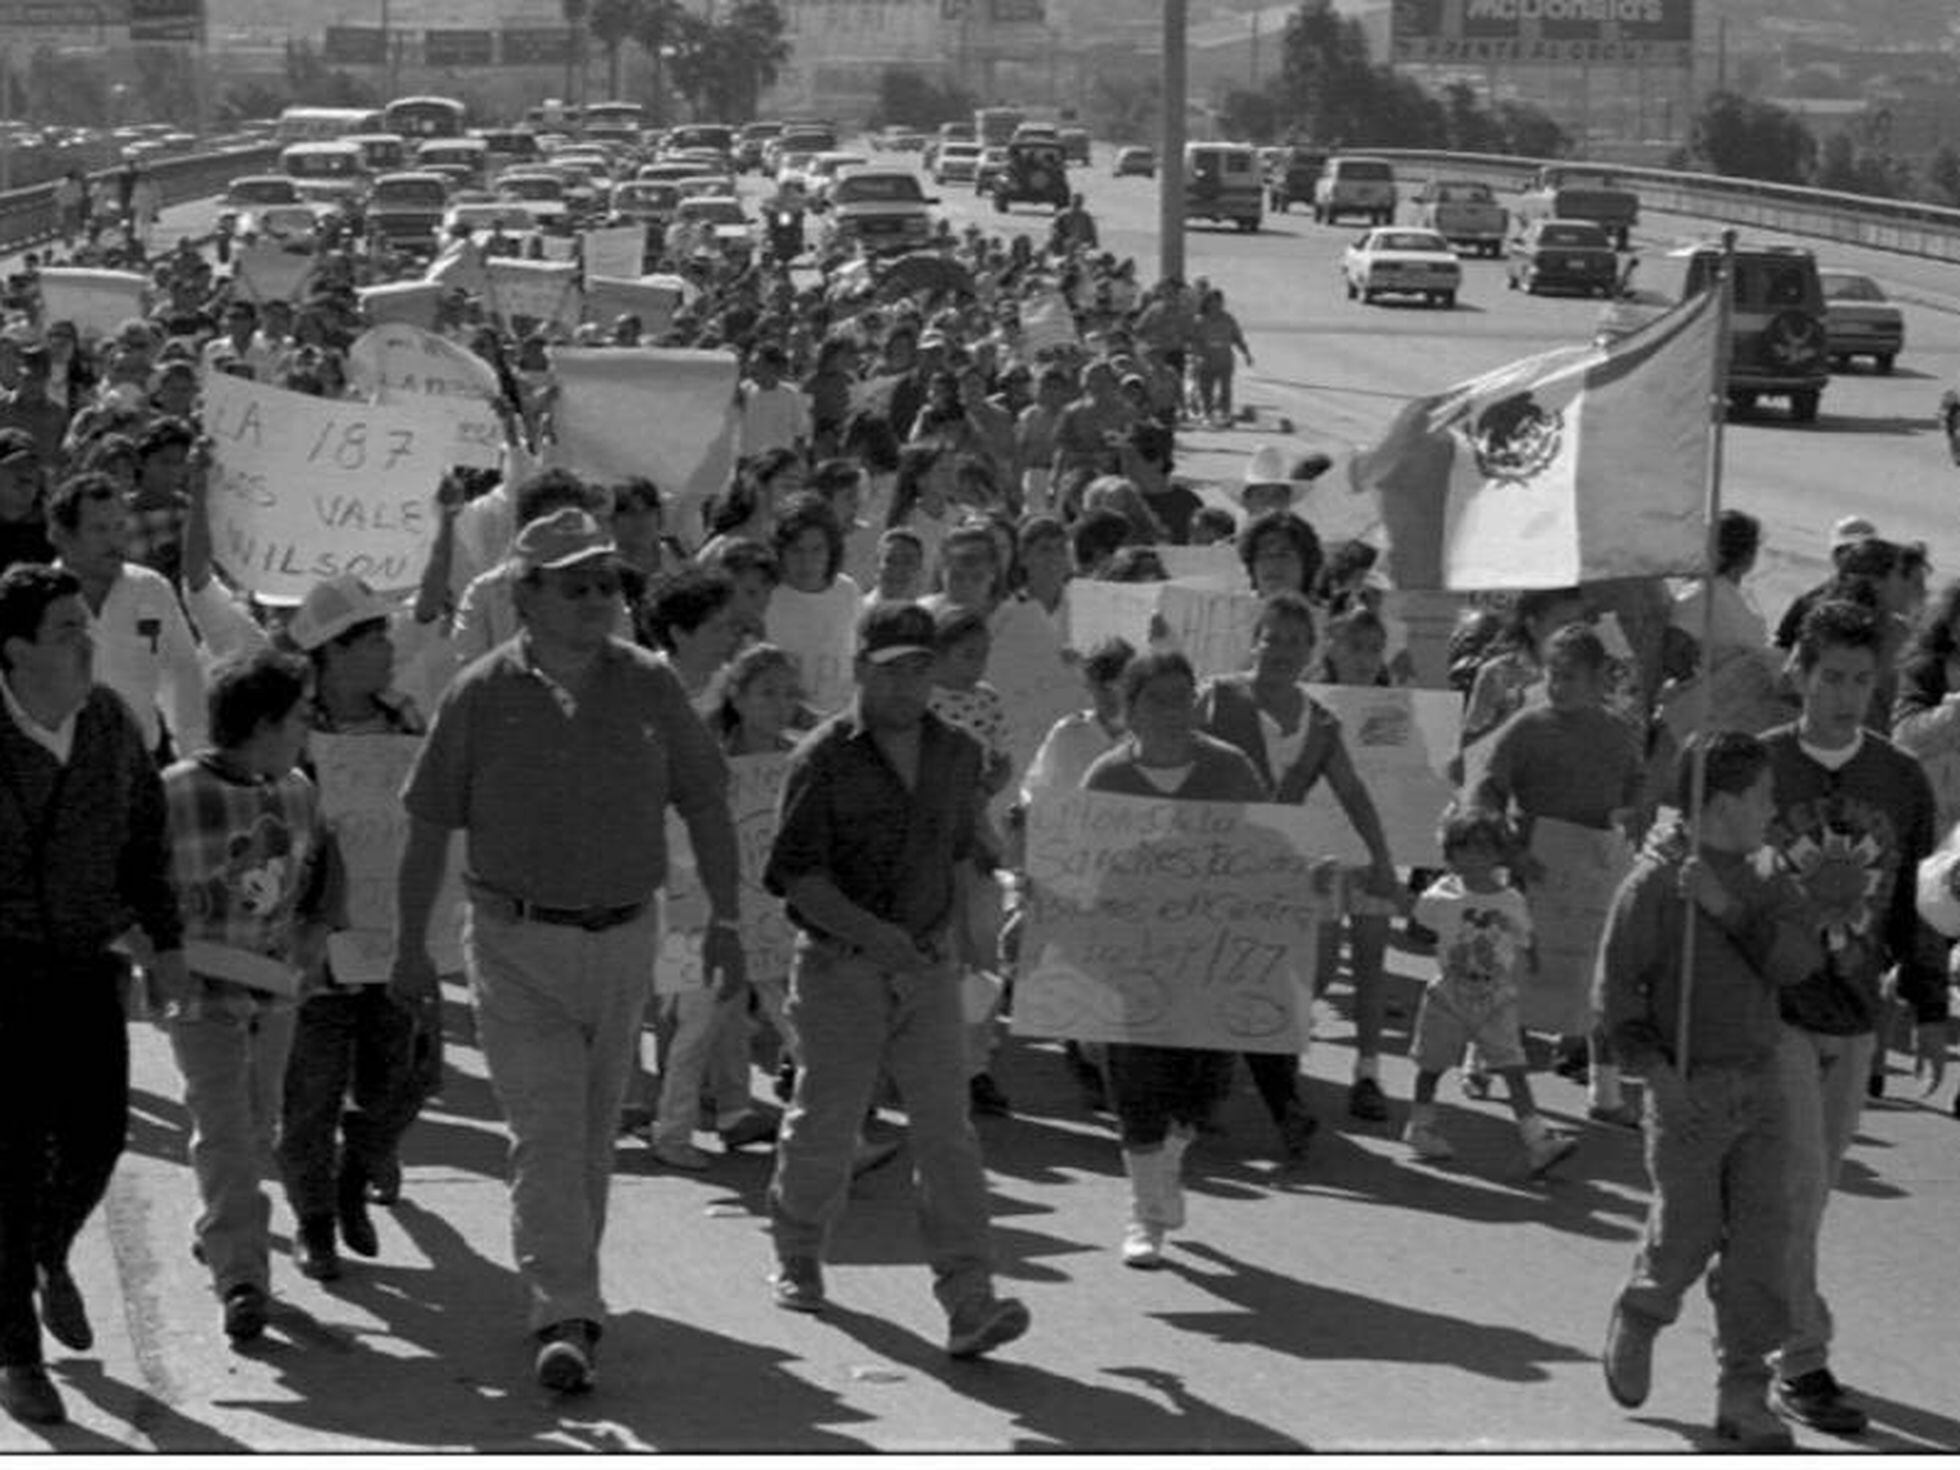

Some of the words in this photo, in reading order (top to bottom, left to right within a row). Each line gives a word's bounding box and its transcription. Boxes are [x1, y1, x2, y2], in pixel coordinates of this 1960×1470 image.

[307, 420, 414, 470] 187
[314, 495, 423, 535] VALE
[226, 518, 407, 578] WILSON
